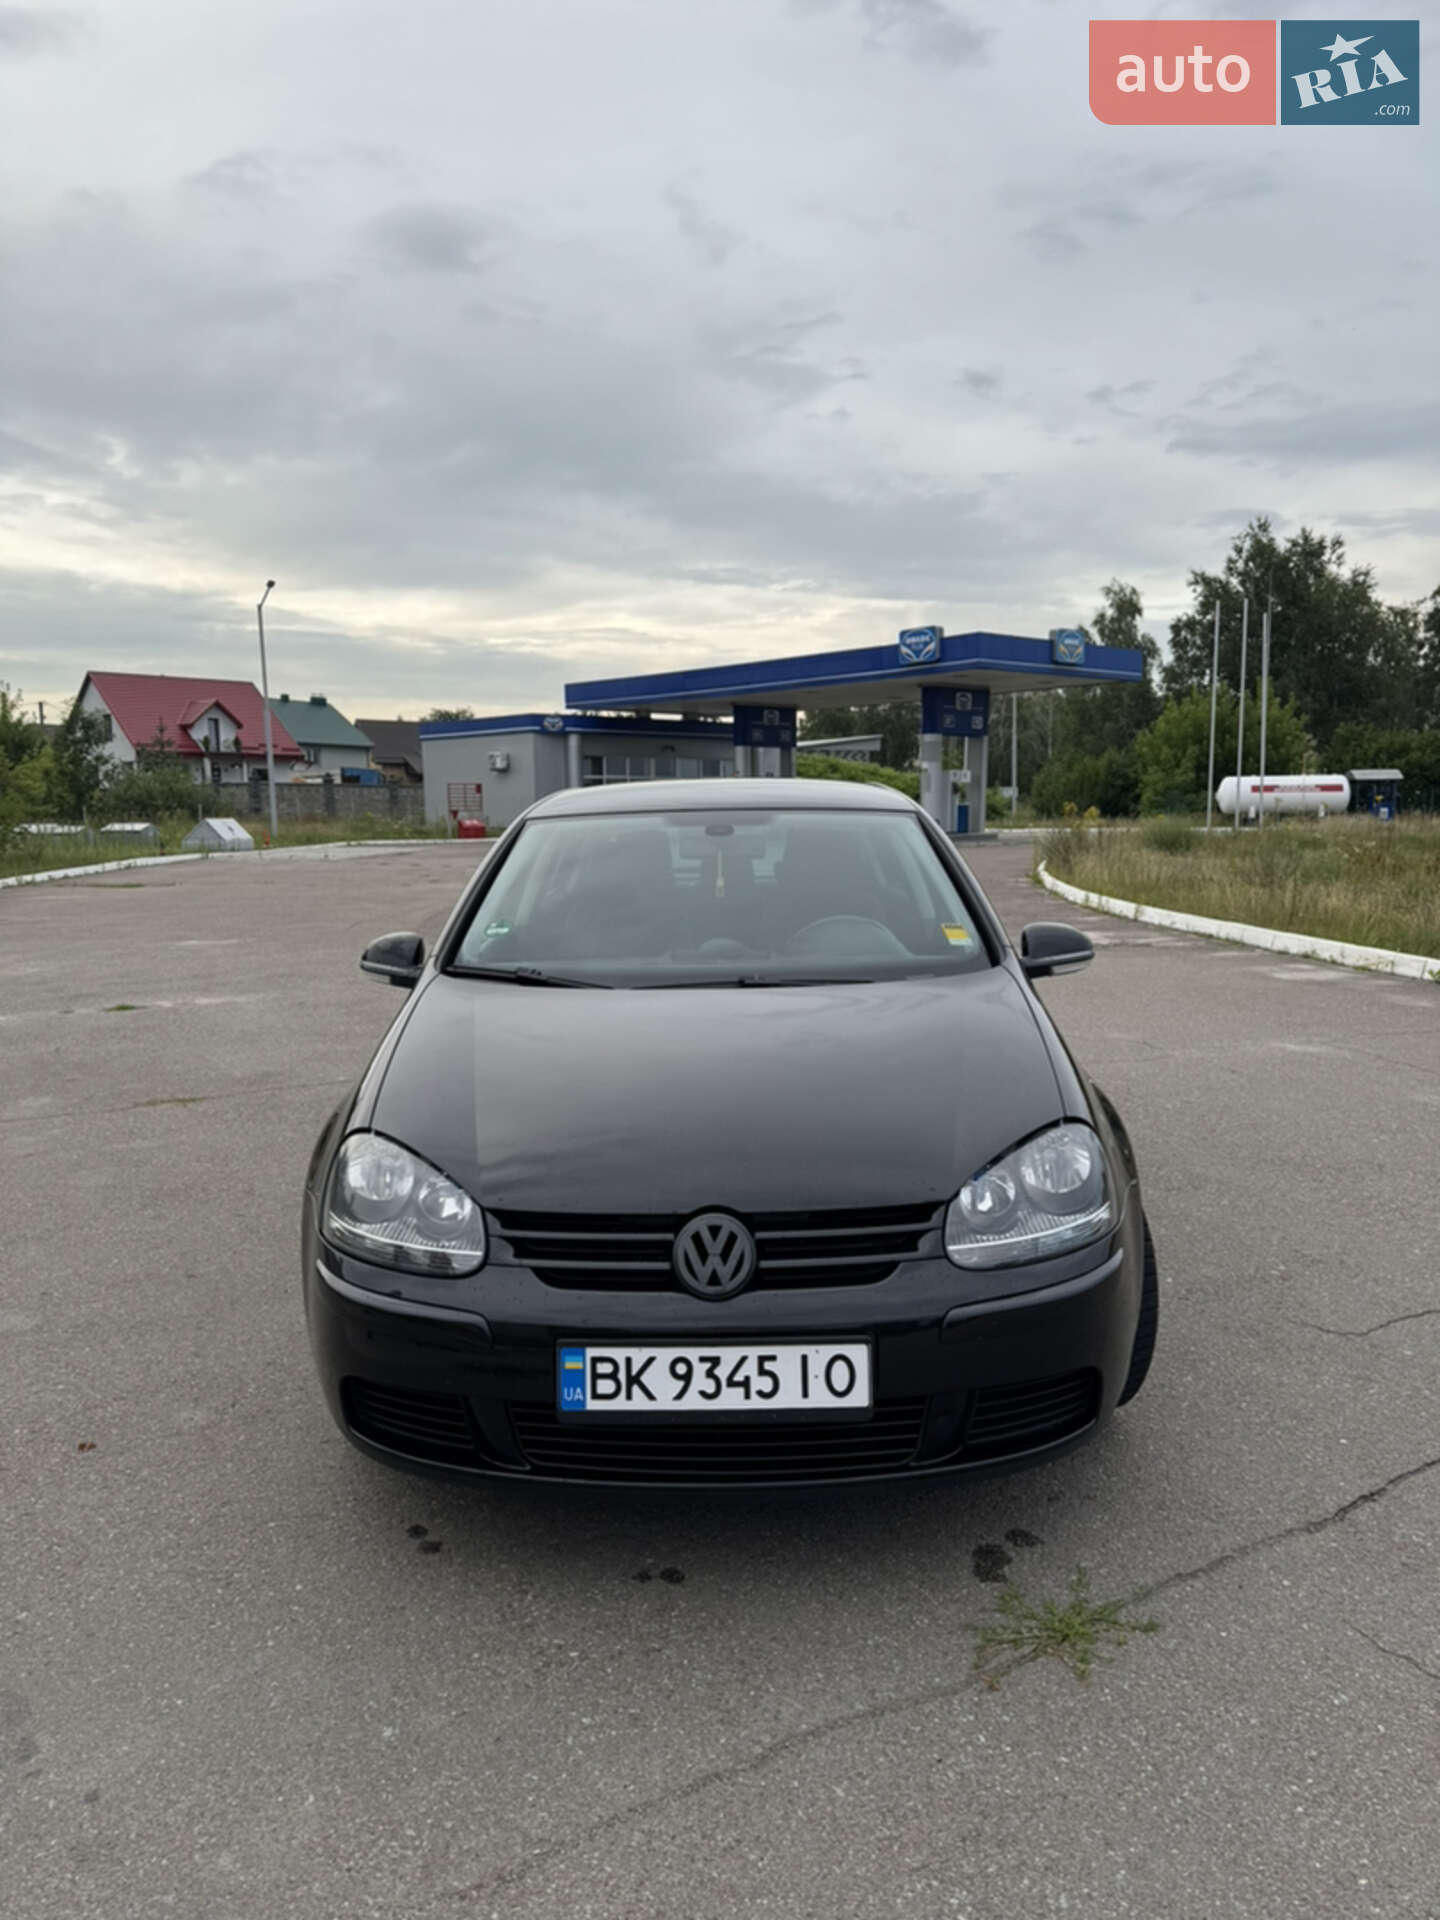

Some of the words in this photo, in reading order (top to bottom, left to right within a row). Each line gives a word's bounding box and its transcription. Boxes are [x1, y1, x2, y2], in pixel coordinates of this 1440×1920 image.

[590, 1356, 657, 1401] BK
[669, 1354, 780, 1401] 9345
[564, 1387, 584, 1401] UA
